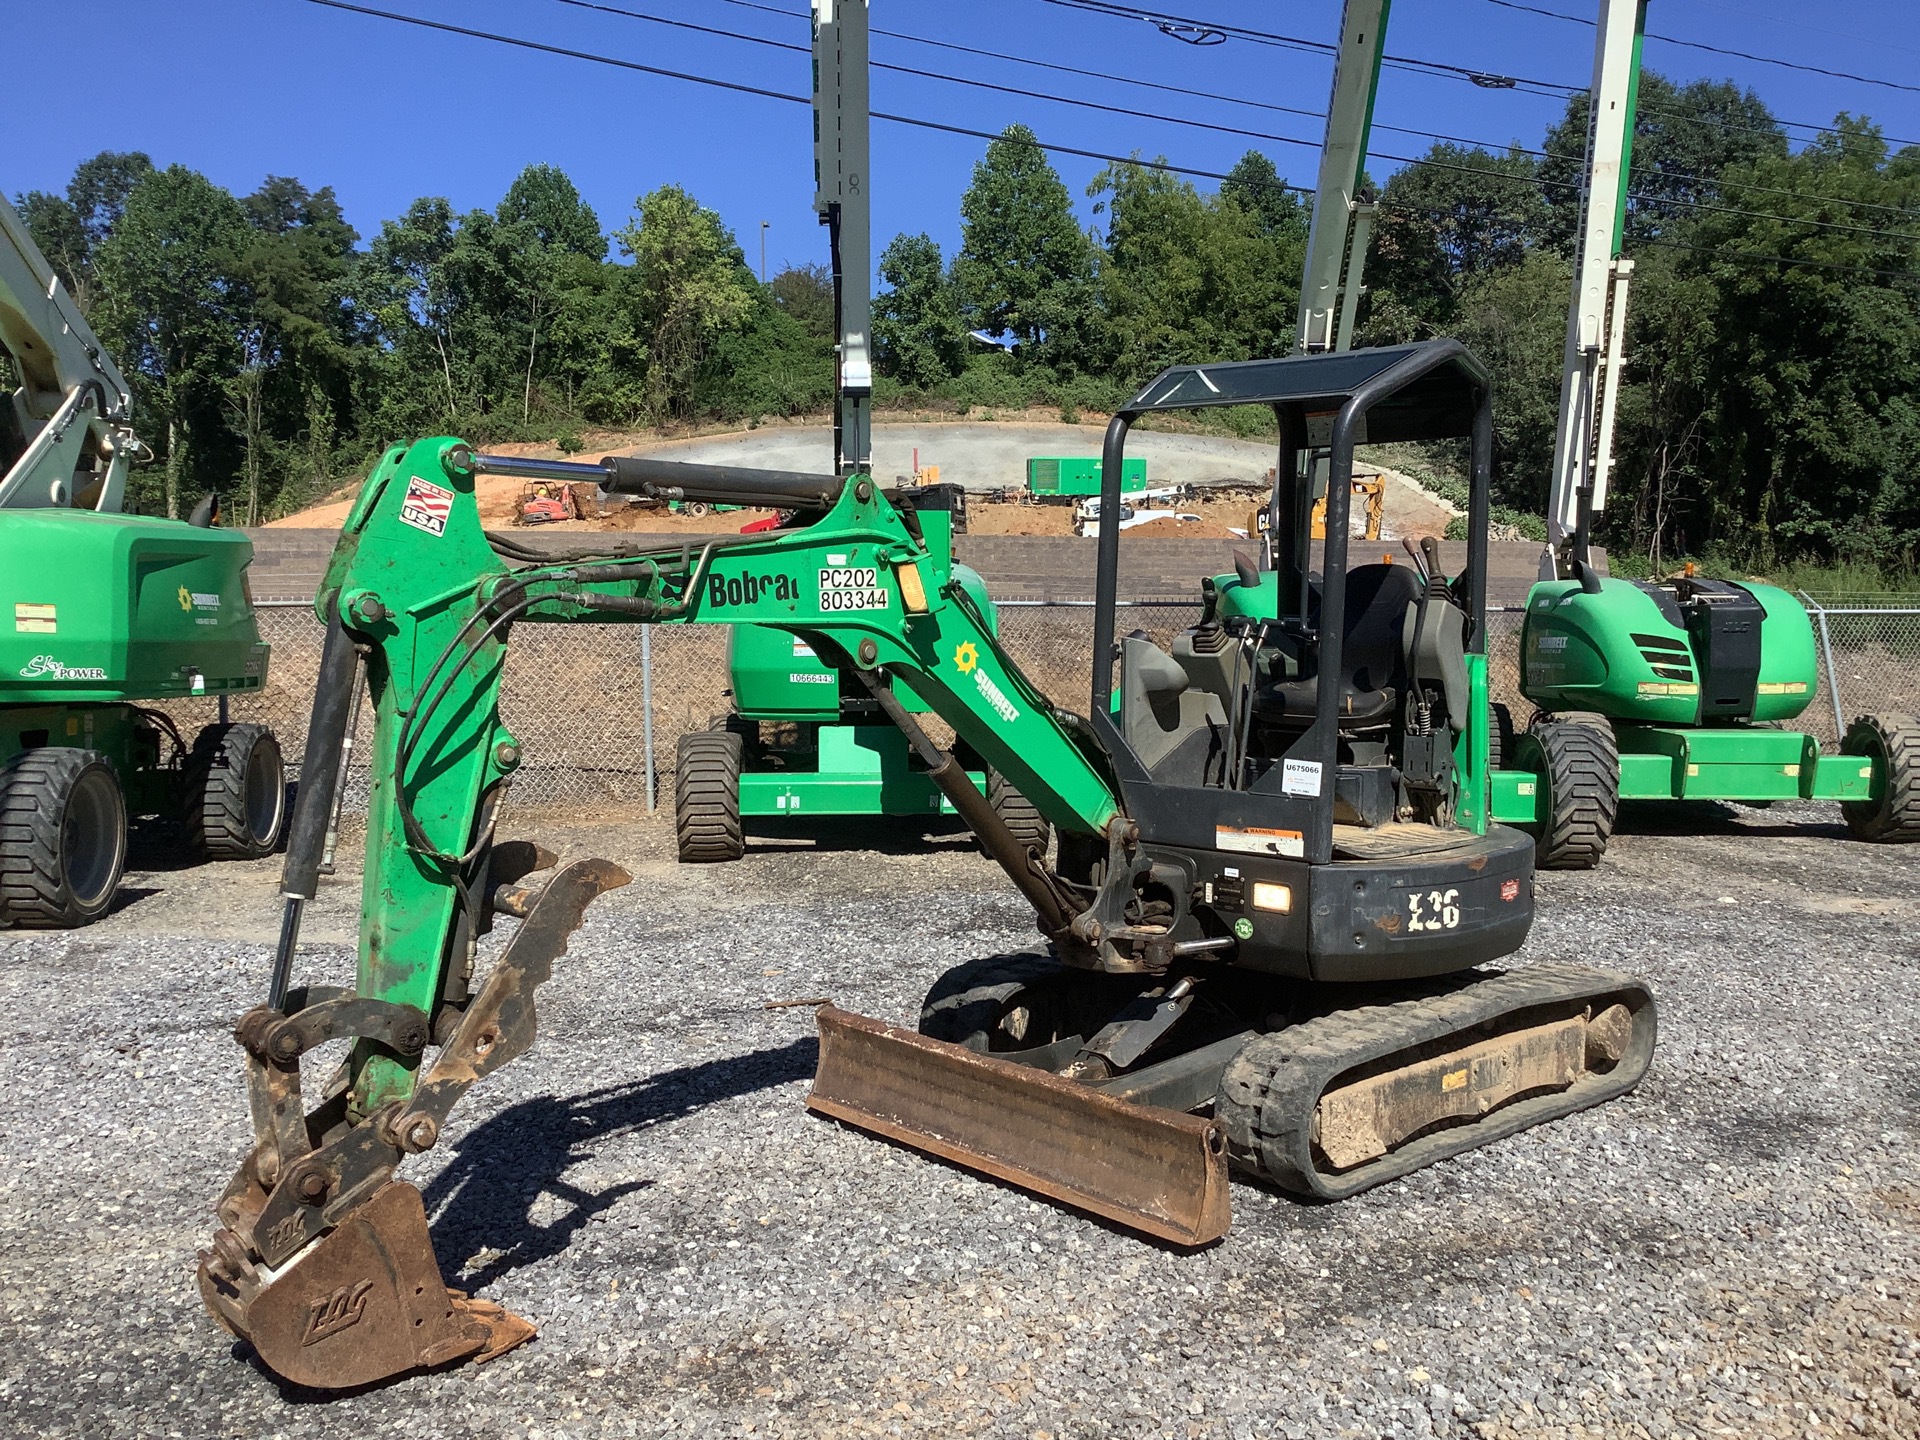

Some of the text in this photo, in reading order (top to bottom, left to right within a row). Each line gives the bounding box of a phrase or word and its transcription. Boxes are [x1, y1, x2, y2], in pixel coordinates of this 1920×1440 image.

[413, 479, 431, 491] MADE
[439, 489, 451, 499] THE
[403, 507, 441, 532] USA
[820, 569, 875, 588] PC202
[821, 590, 887, 610] 803344
[1538, 636, 1568, 649] SUNBELT
[791, 674, 834, 683] 10666443
[974, 667, 1021, 723] SUNBELT
[976, 684, 1009, 722] RENTALS
[1286, 764, 1319, 774] U675066
